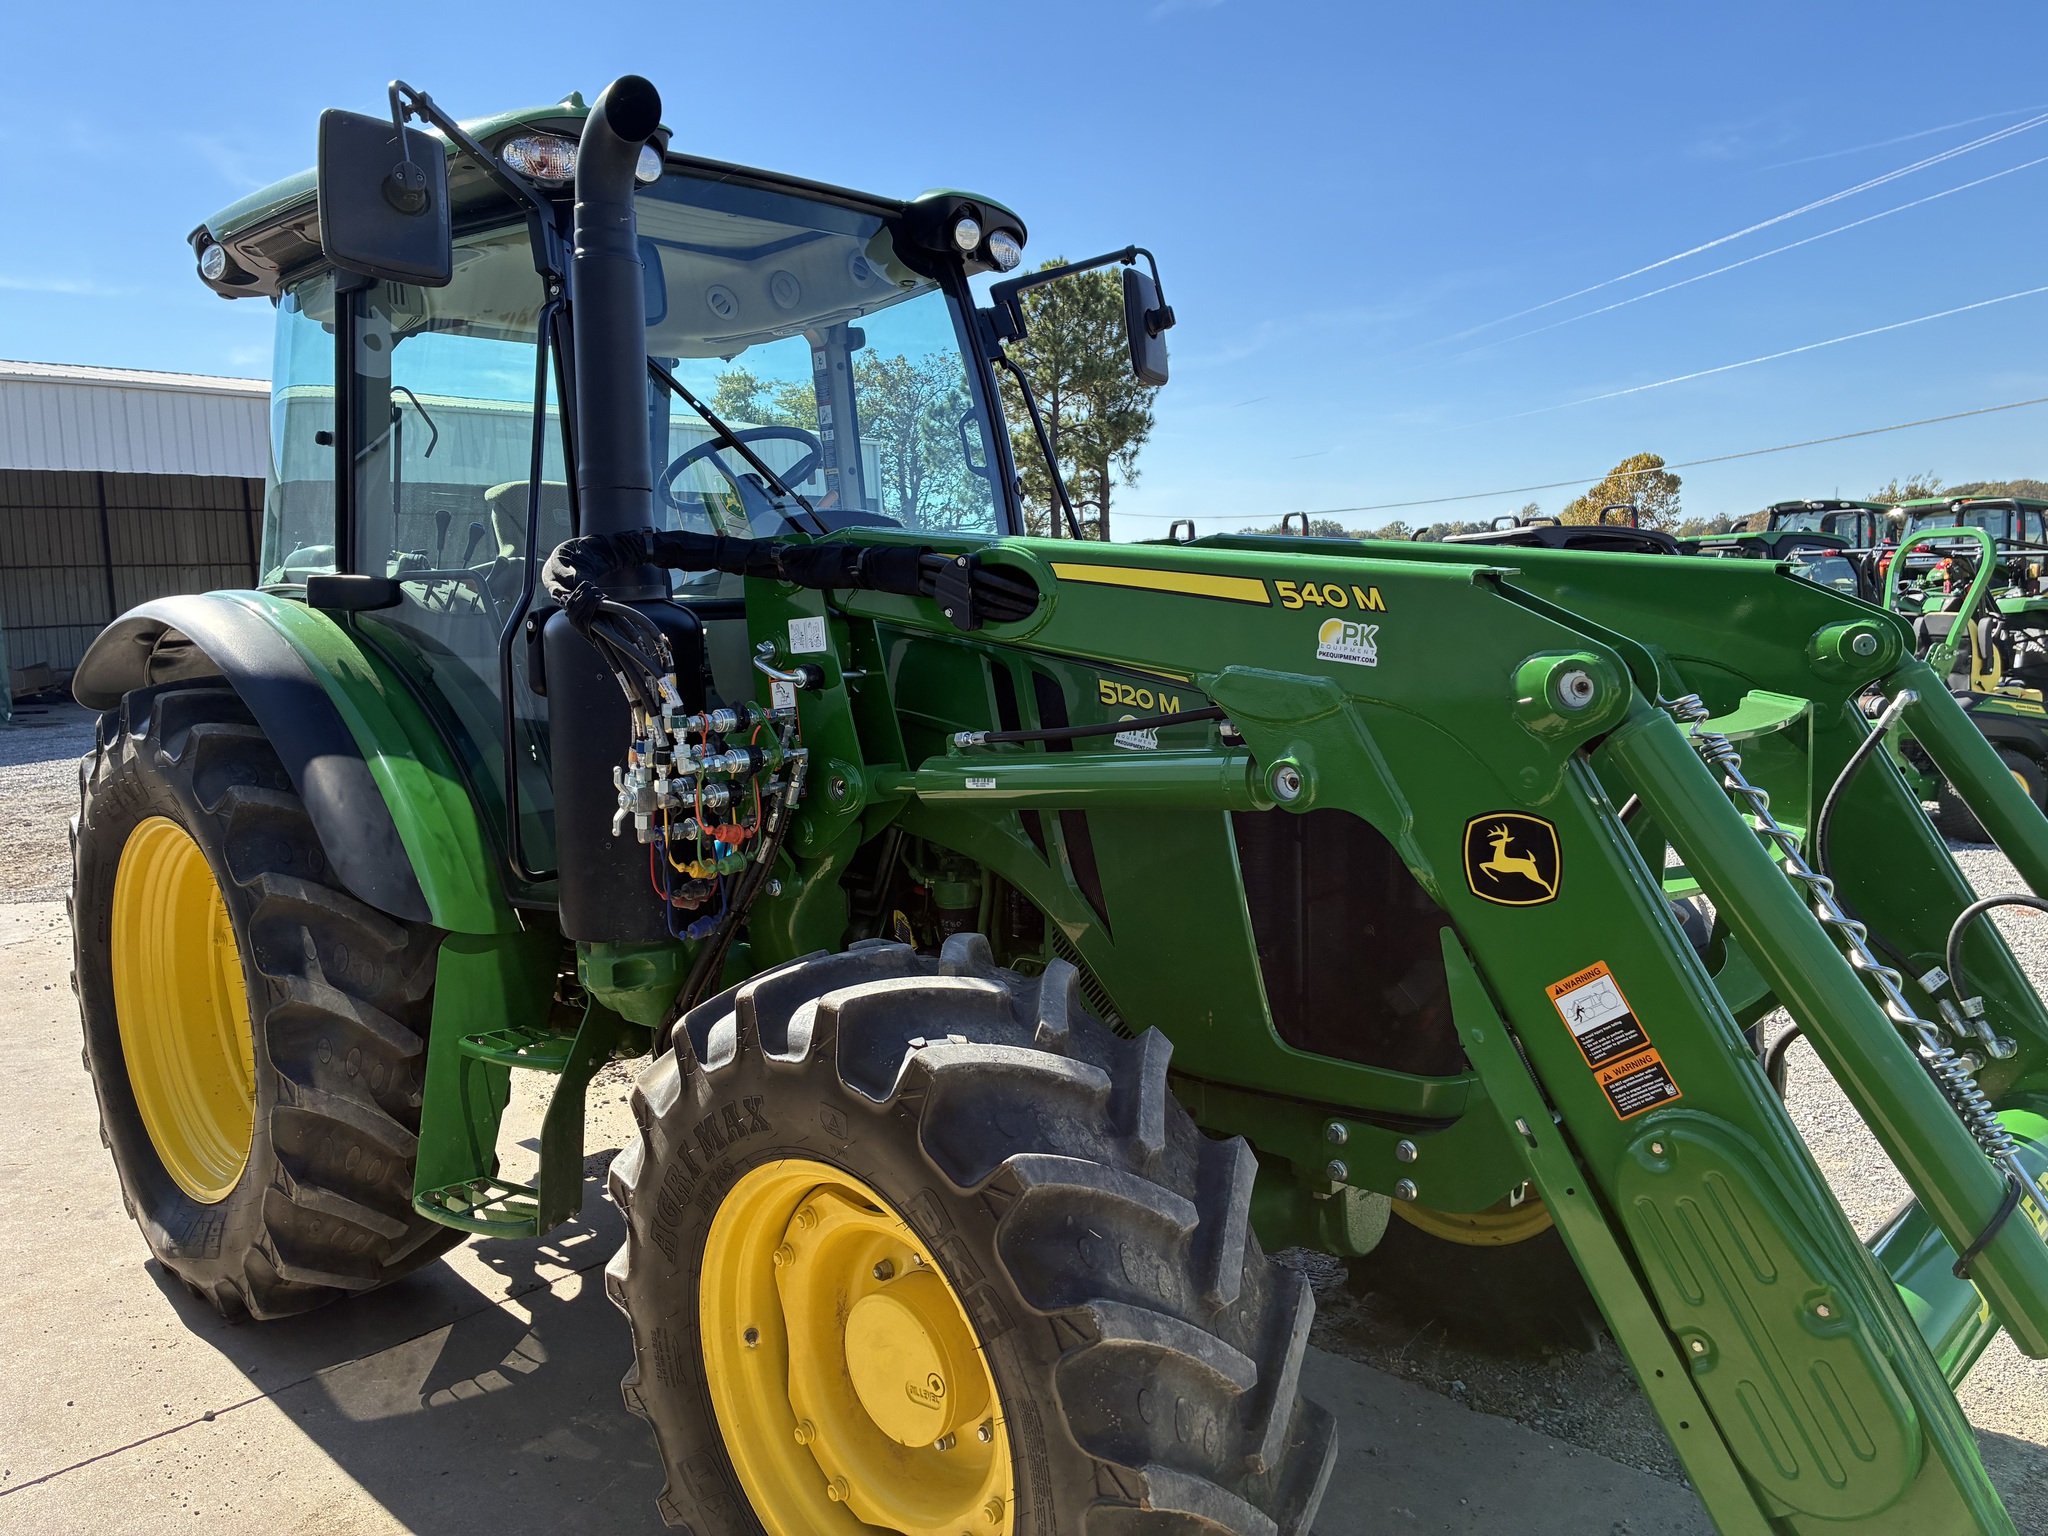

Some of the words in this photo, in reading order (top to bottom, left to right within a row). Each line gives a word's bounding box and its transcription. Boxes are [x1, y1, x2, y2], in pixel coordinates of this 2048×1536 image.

[1273, 580, 1349, 609] 540
[1350, 585, 1387, 612] M
[1318, 650, 1375, 664] PKEQUIPMENT.COM
[1320, 643, 1375, 655] EQUIPMENT
[1098, 678, 1155, 710] 5120
[1158, 692, 1180, 714] M
[1117, 733, 1156, 746] EQUIPMENT
[1562, 967, 1602, 990] WARNING
[1612, 1055, 1653, 1076] WARNING
